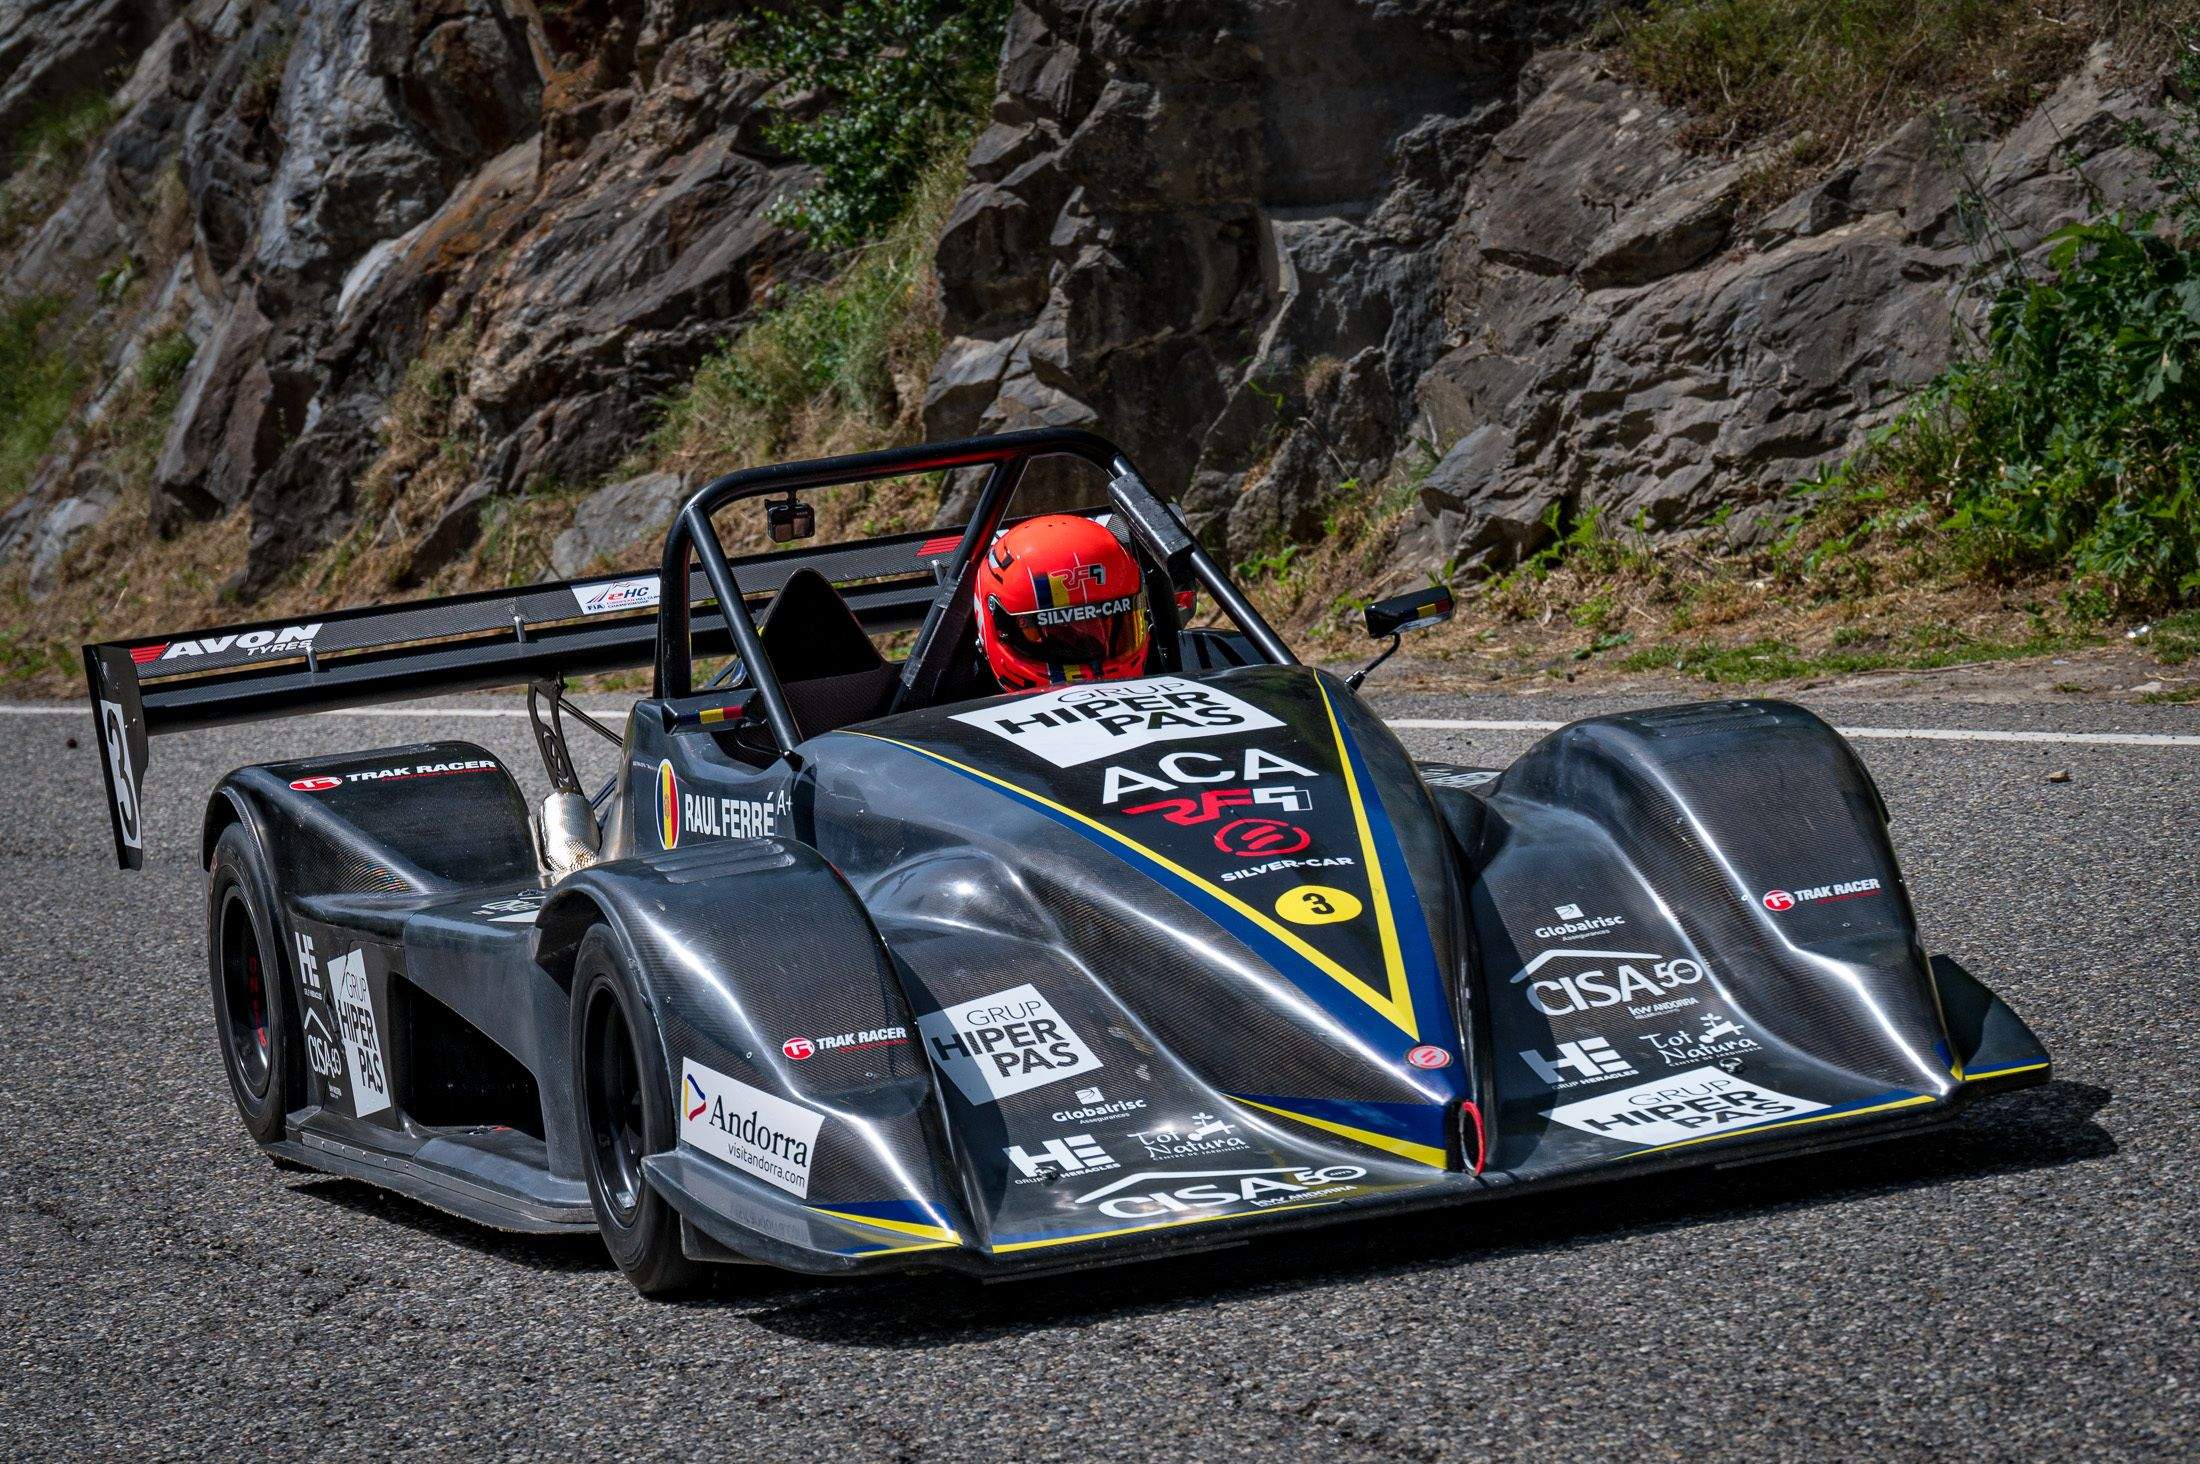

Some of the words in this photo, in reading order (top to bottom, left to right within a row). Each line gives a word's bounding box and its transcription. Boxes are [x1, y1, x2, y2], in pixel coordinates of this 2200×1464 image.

[1037, 597, 1131, 626] SILVER-CAR
[161, 623, 323, 660] AVON
[246, 639, 313, 656] TYRES
[1057, 682, 1185, 703] GRUP
[995, 691, 1223, 735] HIPER
[1095, 705, 1245, 736] PAS
[106, 708, 137, 841] 3
[346, 767, 411, 782] TRAK
[416, 760, 496, 774] RACER
[1102, 748, 1320, 805] ACA
[685, 793, 721, 837] RAUL
[721, 791, 775, 839] FERRÉ
[1220, 857, 1355, 882] SILVER-CAR
[1302, 892, 1335, 915] 3
[1794, 885, 1833, 902] TRAK
[1832, 878, 1881, 896] RACER
[1535, 914, 1626, 939] Globalrisc
[295, 931, 321, 989] HE
[345, 971, 368, 1002] GRUP
[1526, 964, 1667, 1016] CISA
[1653, 958, 1703, 988] 50
[966, 1000, 1041, 1026] GRUP
[1652, 997, 1699, 1012] ANDORRA
[337, 999, 378, 1051] HIPER
[816, 1032, 855, 1050] TRAK
[858, 1027, 907, 1043] RACER
[930, 1018, 1066, 1061] HIPER
[1639, 1030, 1693, 1049] Tot
[308, 1034, 336, 1079] CISA
[992, 1042, 1079, 1078] PAS
[1519, 1037, 1633, 1084] HE
[1658, 1038, 1758, 1064] Natura
[358, 1048, 384, 1095] PAS
[1580, 1069, 1640, 1085] HERACLES
[1628, 1079, 1732, 1106] GRUP
[1051, 1099, 1147, 1123] Globalrisc
[1582, 1091, 1772, 1132] HIPER
[1672, 1101, 1797, 1129] PAS
[708, 1094, 808, 1168] Andorra
[1126, 1130, 1181, 1146] Tot
[1004, 1133, 1116, 1178] HE
[1144, 1137, 1247, 1159] Natura
[728, 1142, 806, 1189] visitandorra.com
[1060, 1162, 1122, 1179] HERACLES
[1098, 1177, 1309, 1219] CISA
[1294, 1165, 1367, 1186] 50
